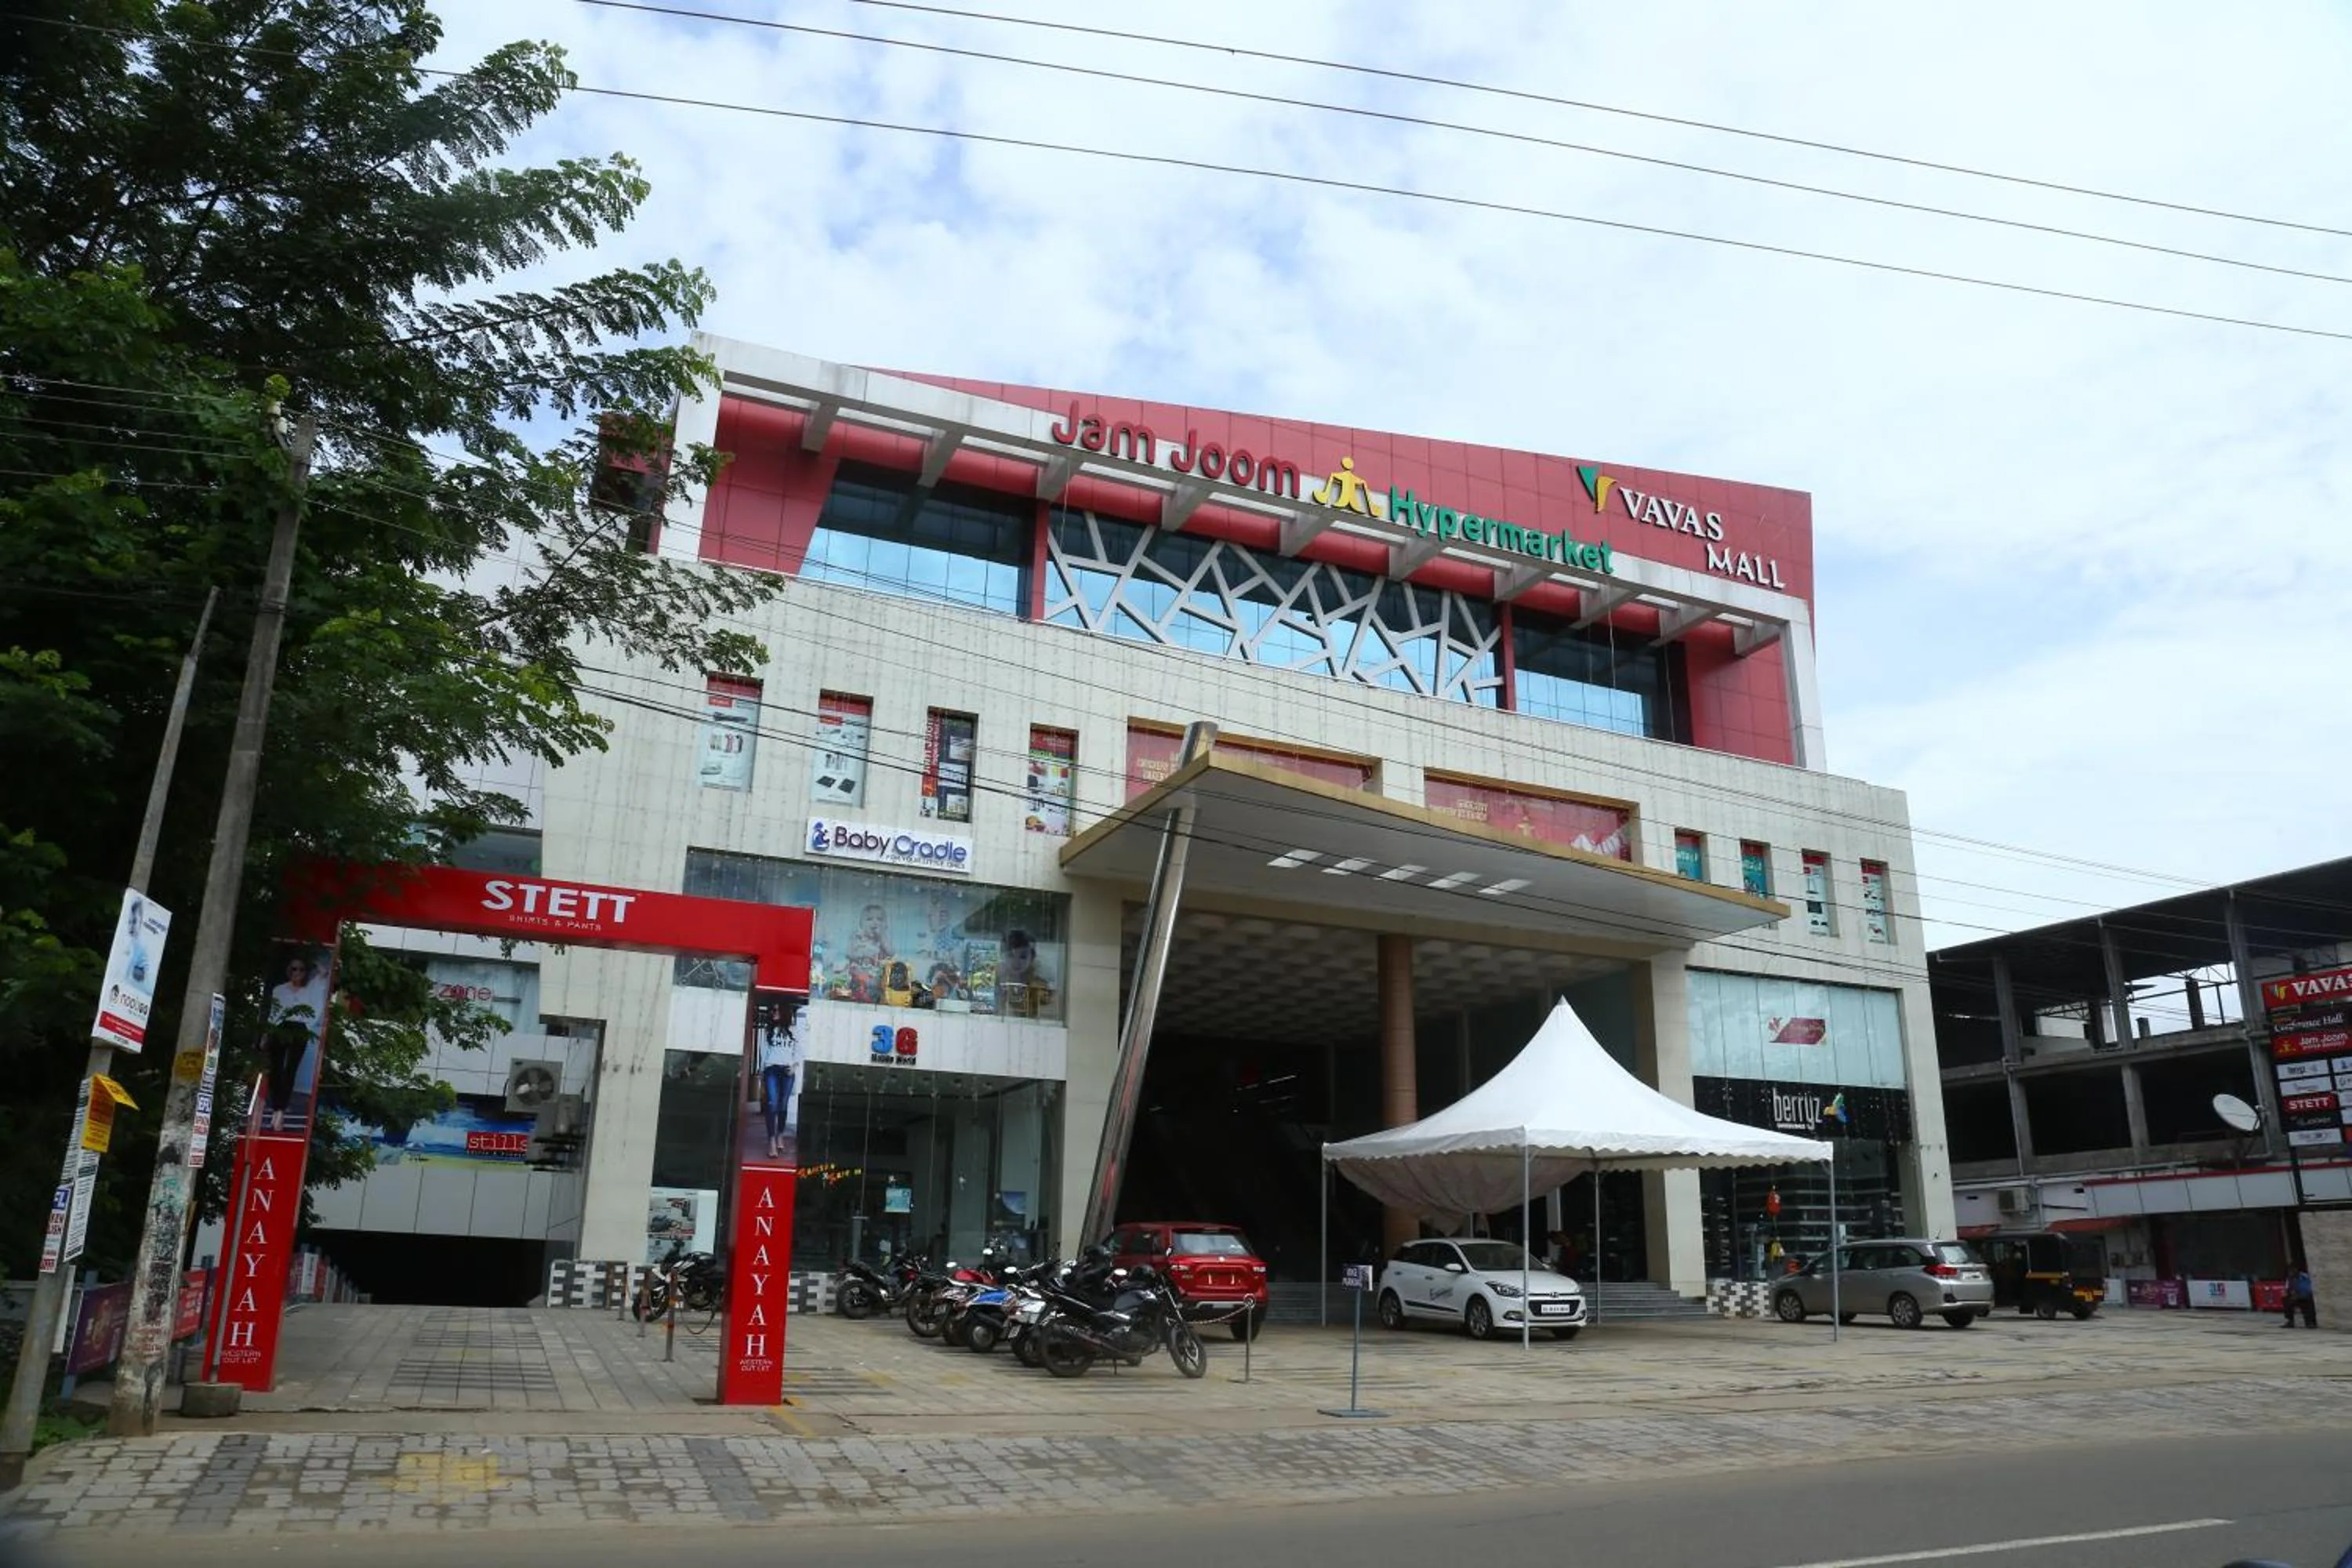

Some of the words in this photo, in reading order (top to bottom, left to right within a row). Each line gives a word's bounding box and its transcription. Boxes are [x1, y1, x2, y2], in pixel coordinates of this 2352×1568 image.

[1051, 400, 1156, 465] Jam
[1171, 429, 1301, 499] Joom
[1389, 485, 1615, 575] Hypermarket
[1619, 487, 1725, 542] VAVAS
[1706, 543, 1787, 590] MALL
[835, 826, 891, 855] Baby
[895, 835, 967, 862] Cradle
[481, 880, 635, 924] STETT
[510, 915, 549, 926] SHIRTS
[567, 921, 602, 931] PANTS
[871, 1025, 918, 1054] 3G
[2288, 1097, 2329, 1110] STETT
[230, 1156, 277, 1347] ANAYAH
[745, 1185, 775, 1357] ANAYAH
